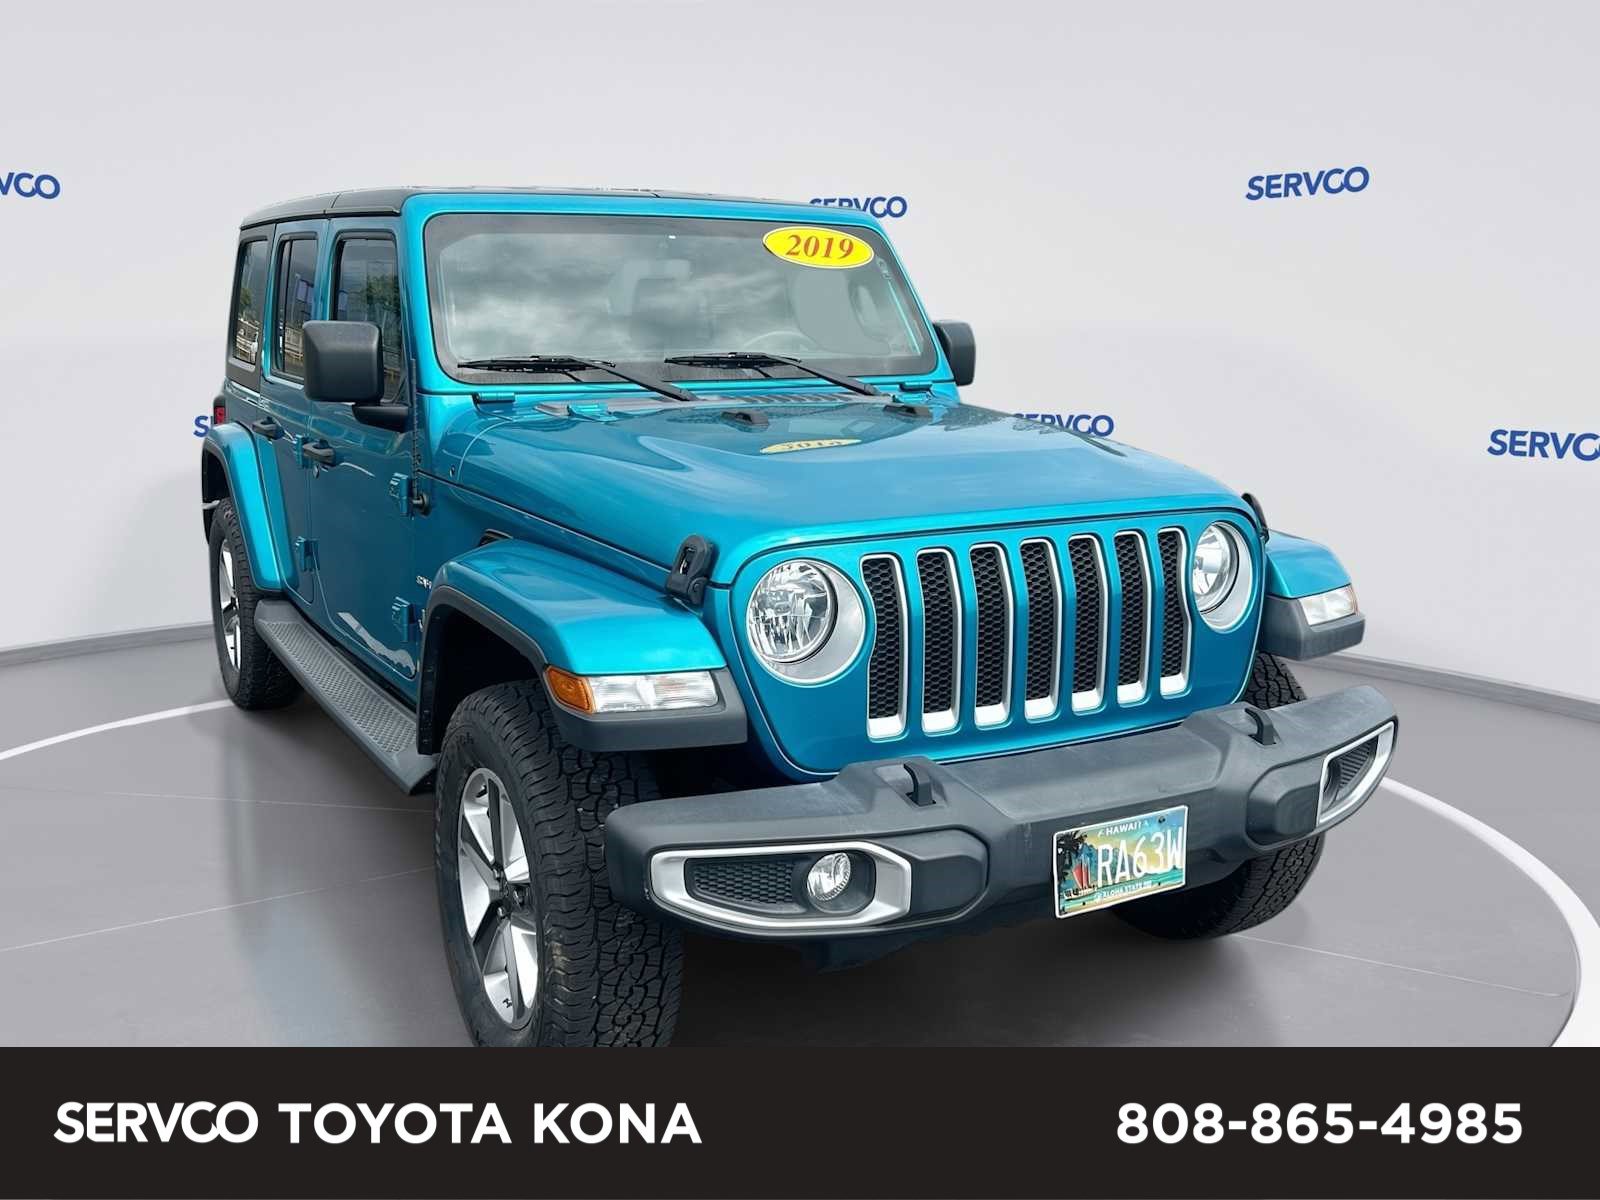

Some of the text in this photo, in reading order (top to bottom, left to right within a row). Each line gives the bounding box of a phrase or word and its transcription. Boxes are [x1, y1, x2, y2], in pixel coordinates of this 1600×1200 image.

[1245, 166, 1370, 201] SERVCO
[809, 196, 908, 219] VCO
[785, 234, 854, 260] 2019
[1014, 413, 1114, 437] VCO
[1487, 429, 1600, 462] SERVC
[1096, 826, 1183, 888] RA63W
